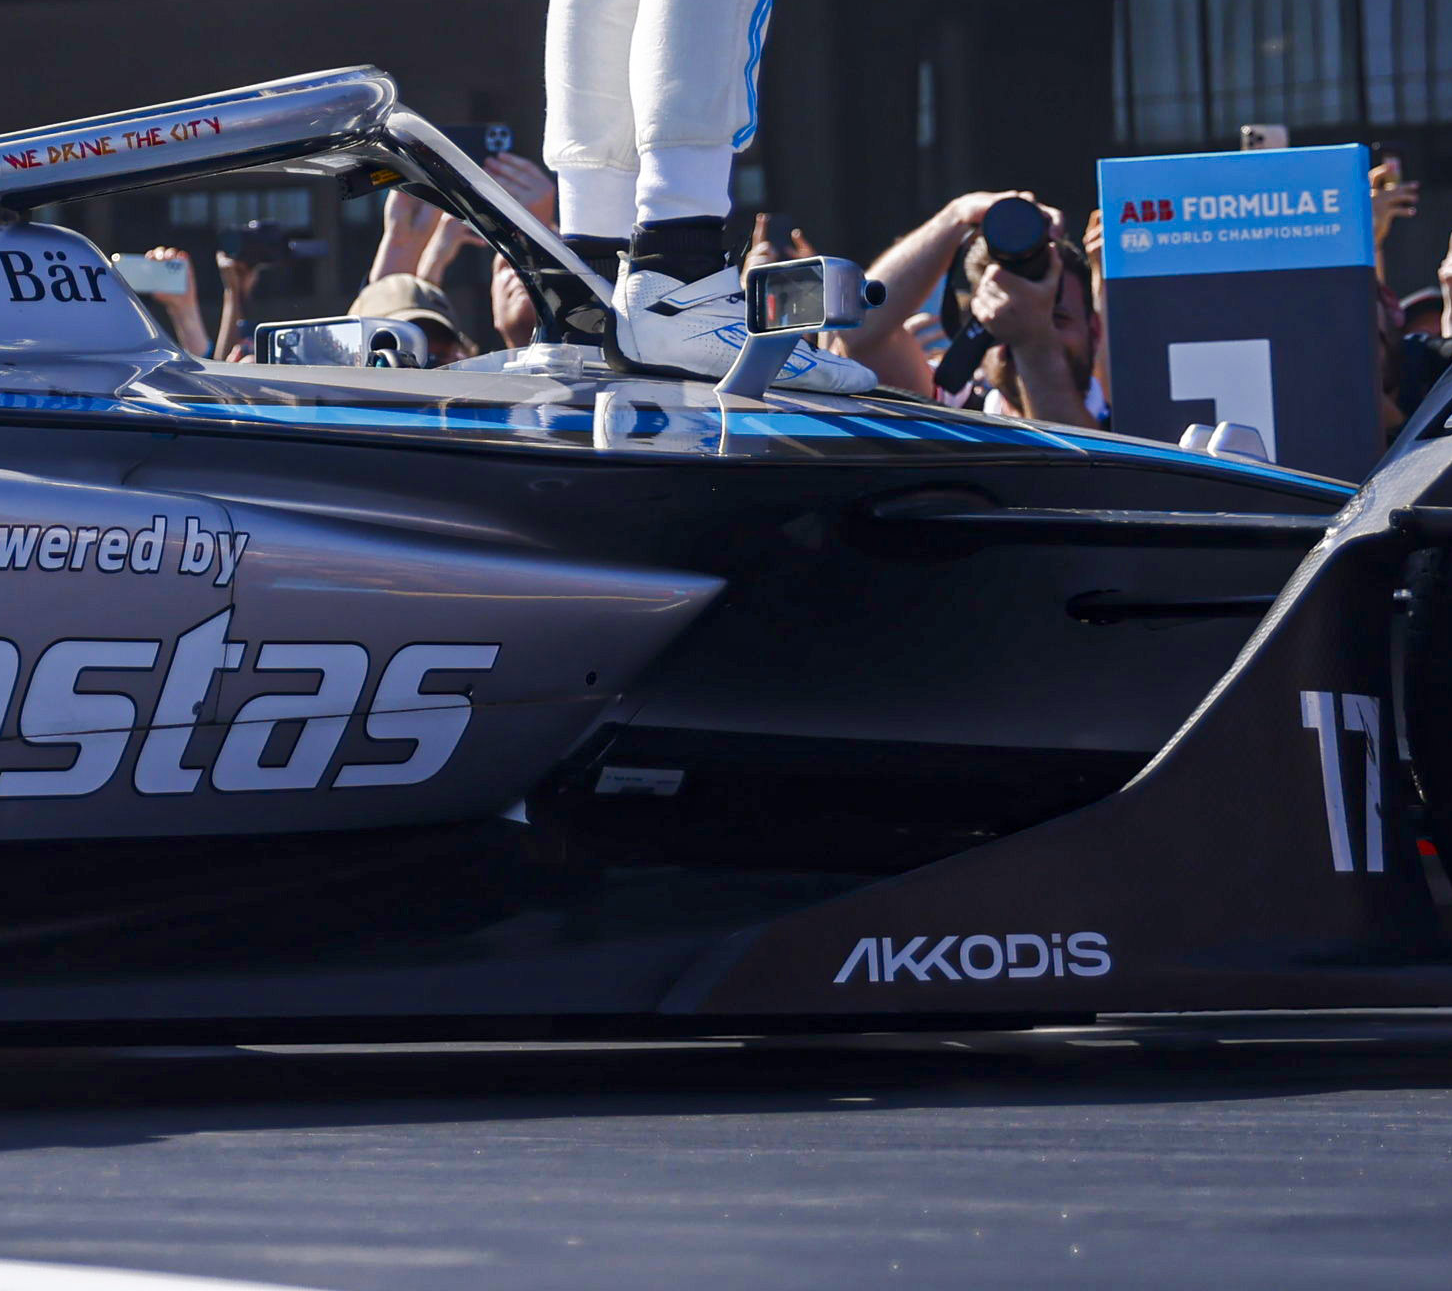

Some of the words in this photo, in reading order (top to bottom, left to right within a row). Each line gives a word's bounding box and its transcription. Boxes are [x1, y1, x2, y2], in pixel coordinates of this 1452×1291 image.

[2, 149, 38, 170] WE
[47, 135, 117, 165] DRIVE
[121, 126, 167, 151] THE
[170, 115, 221, 143] CITY
[1120, 198, 1176, 225] ABB
[1182, 190, 1318, 222] FORMULA
[1322, 188, 1341, 214] E
[1120, 228, 1153, 252] FIA
[1157, 229, 1214, 247] WORLD
[1218, 223, 1342, 243] CHAMPIONSHIP
[181, 515, 250, 587] by
[1299, 690, 1384, 873] 17
